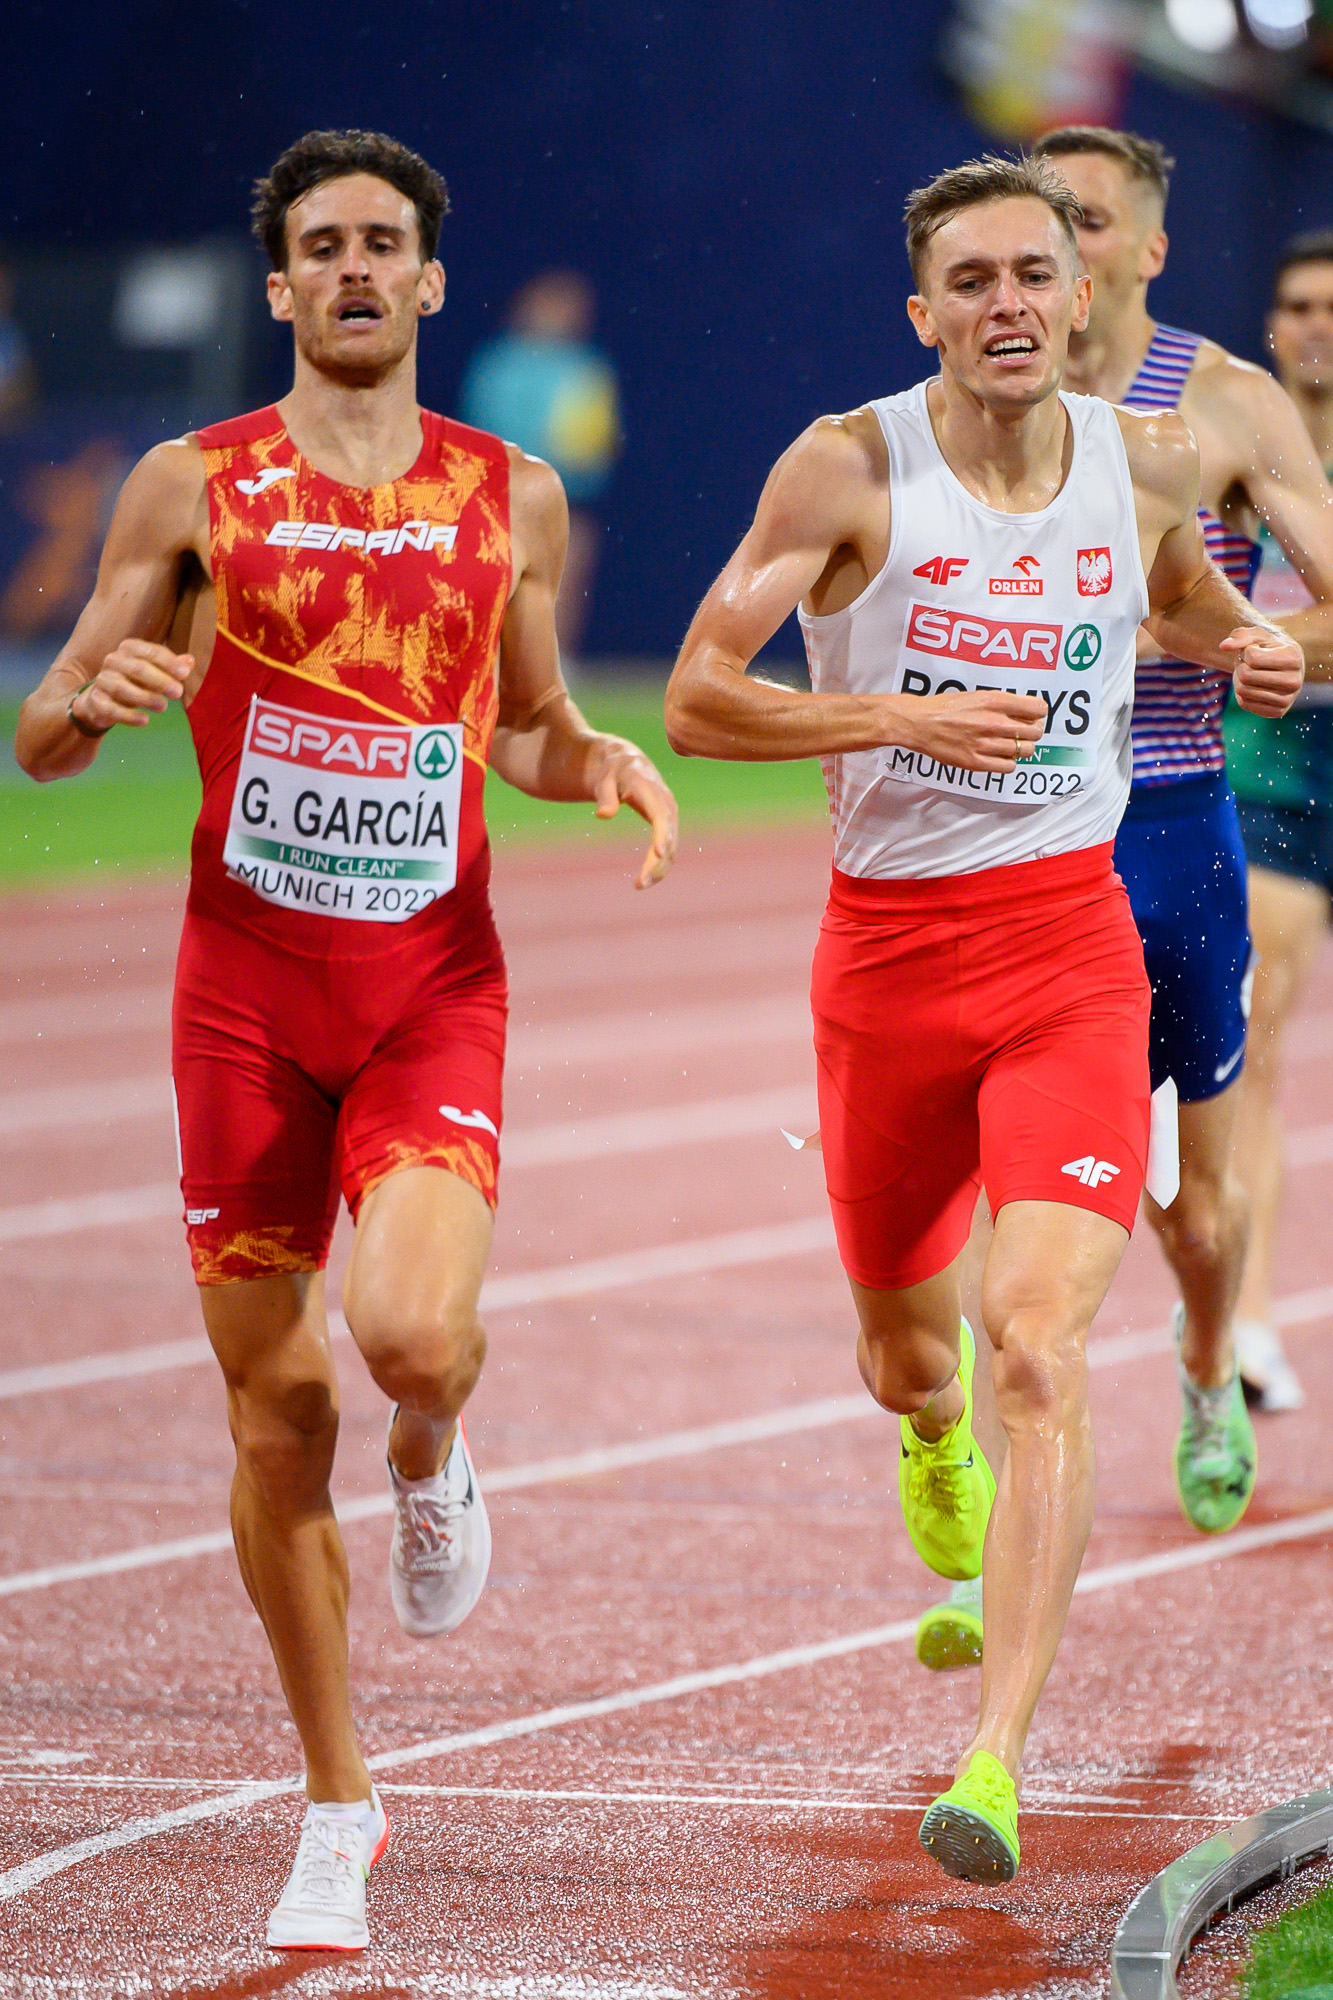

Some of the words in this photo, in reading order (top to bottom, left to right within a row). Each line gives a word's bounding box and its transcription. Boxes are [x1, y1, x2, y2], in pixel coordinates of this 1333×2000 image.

[265, 521, 457, 555] ESPAÑA
[913, 556, 969, 585] 4F
[991, 581, 1040, 594] ORLEN
[911, 613, 1058, 662] SPAR
[252, 713, 408, 772] SPAR
[241, 777, 277, 829] G.
[294, 790, 448, 848] GARCÍA
[289, 848, 331, 872] RUN
[237, 862, 354, 909] MUNICH
[1061, 1155, 1121, 1188] 4F
